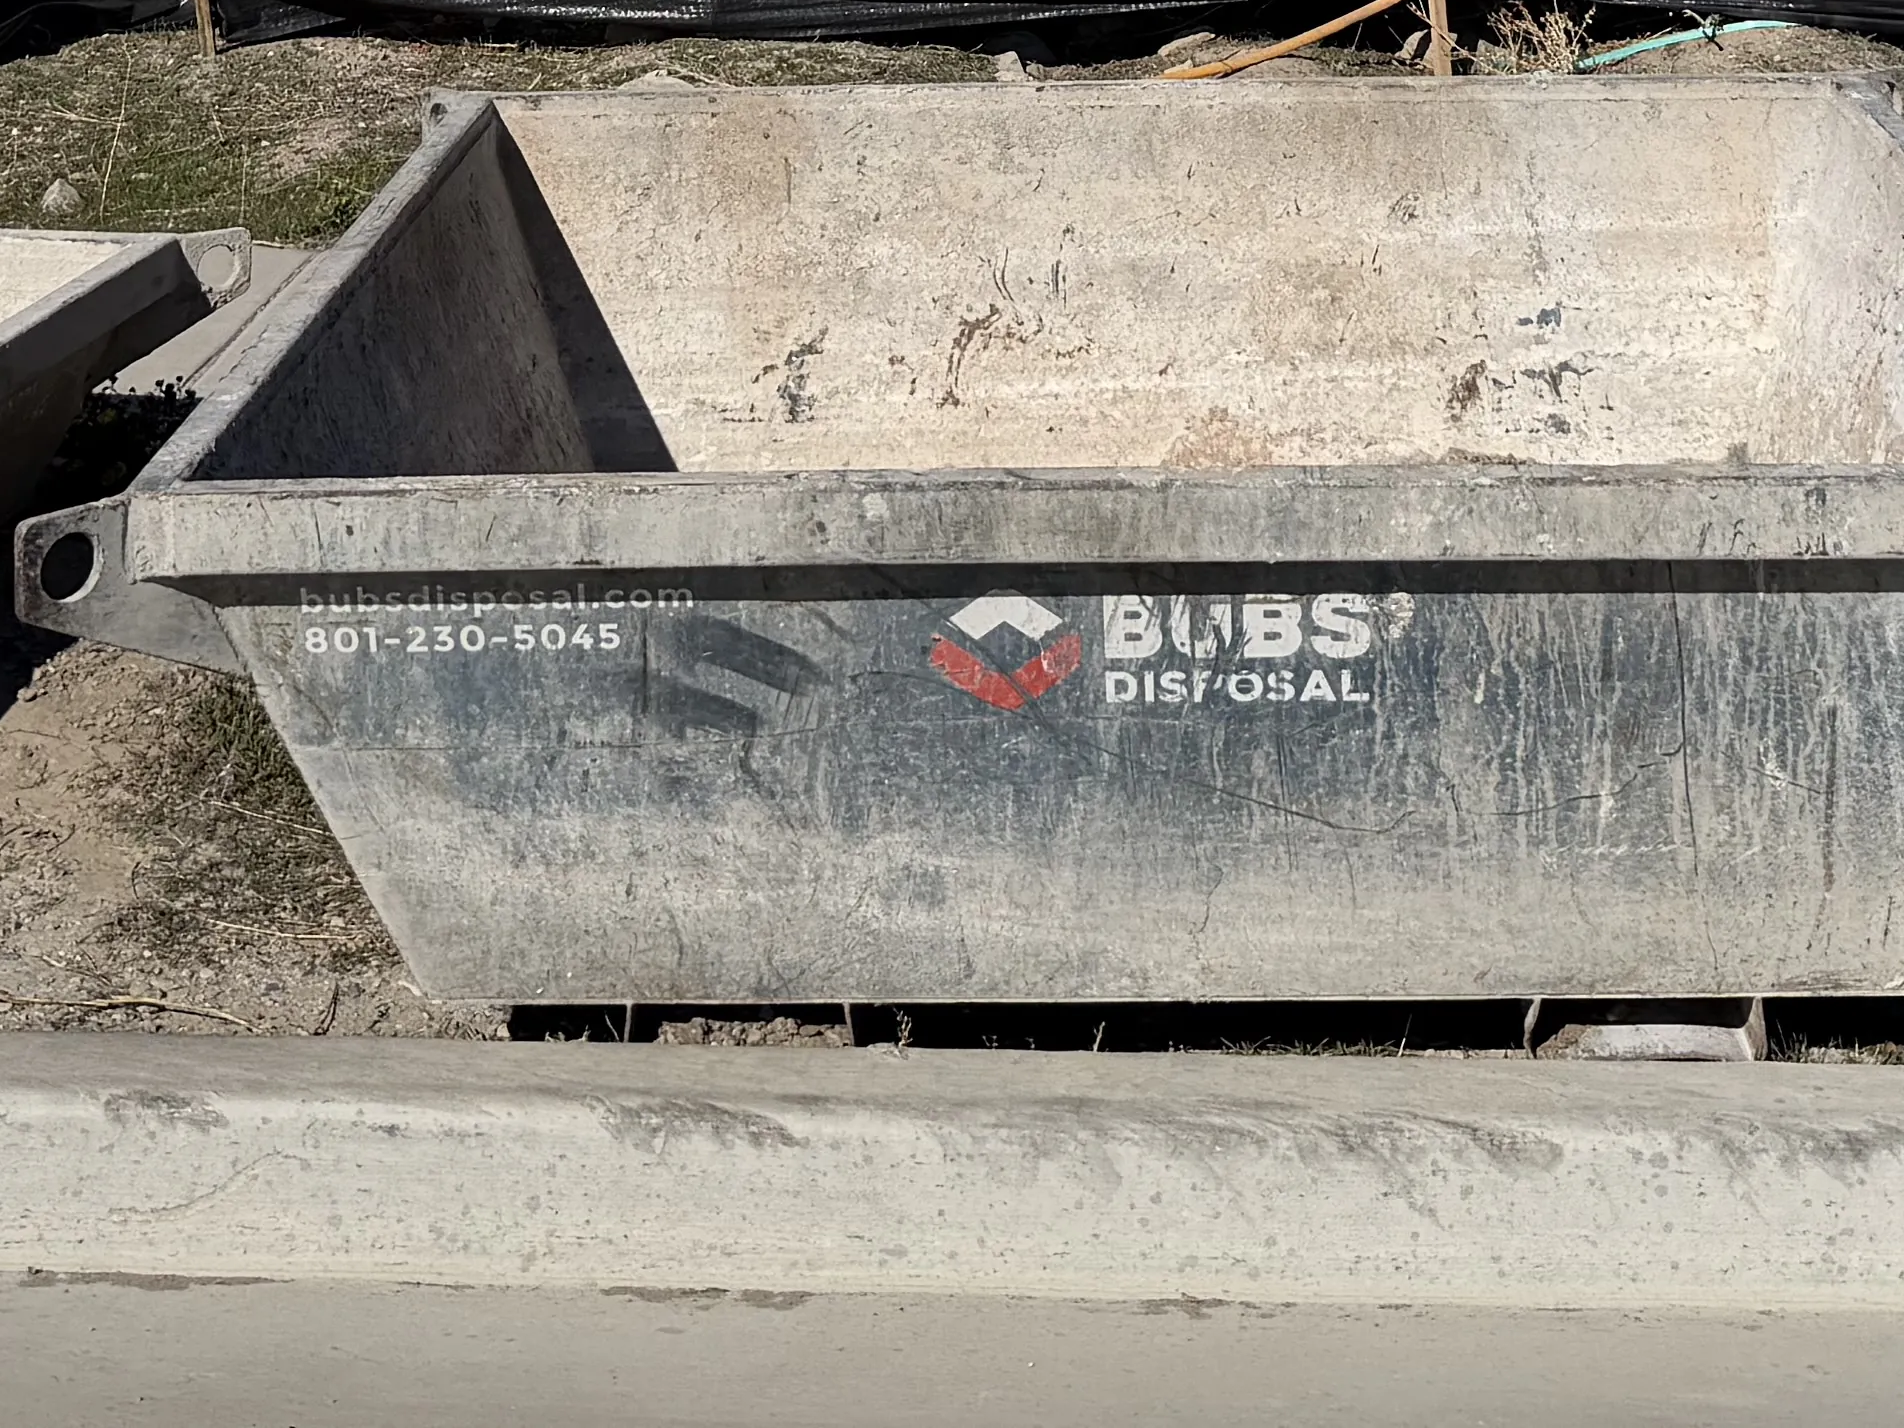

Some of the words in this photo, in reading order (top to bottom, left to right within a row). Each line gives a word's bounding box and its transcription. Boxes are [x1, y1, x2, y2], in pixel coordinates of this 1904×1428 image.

[299, 582, 695, 619] bubsdisposal.com
[304, 622, 622, 654] 801-230-5045
[1102, 591, 1372, 659] BUBS
[1105, 669, 1370, 704] DISPOSAL
